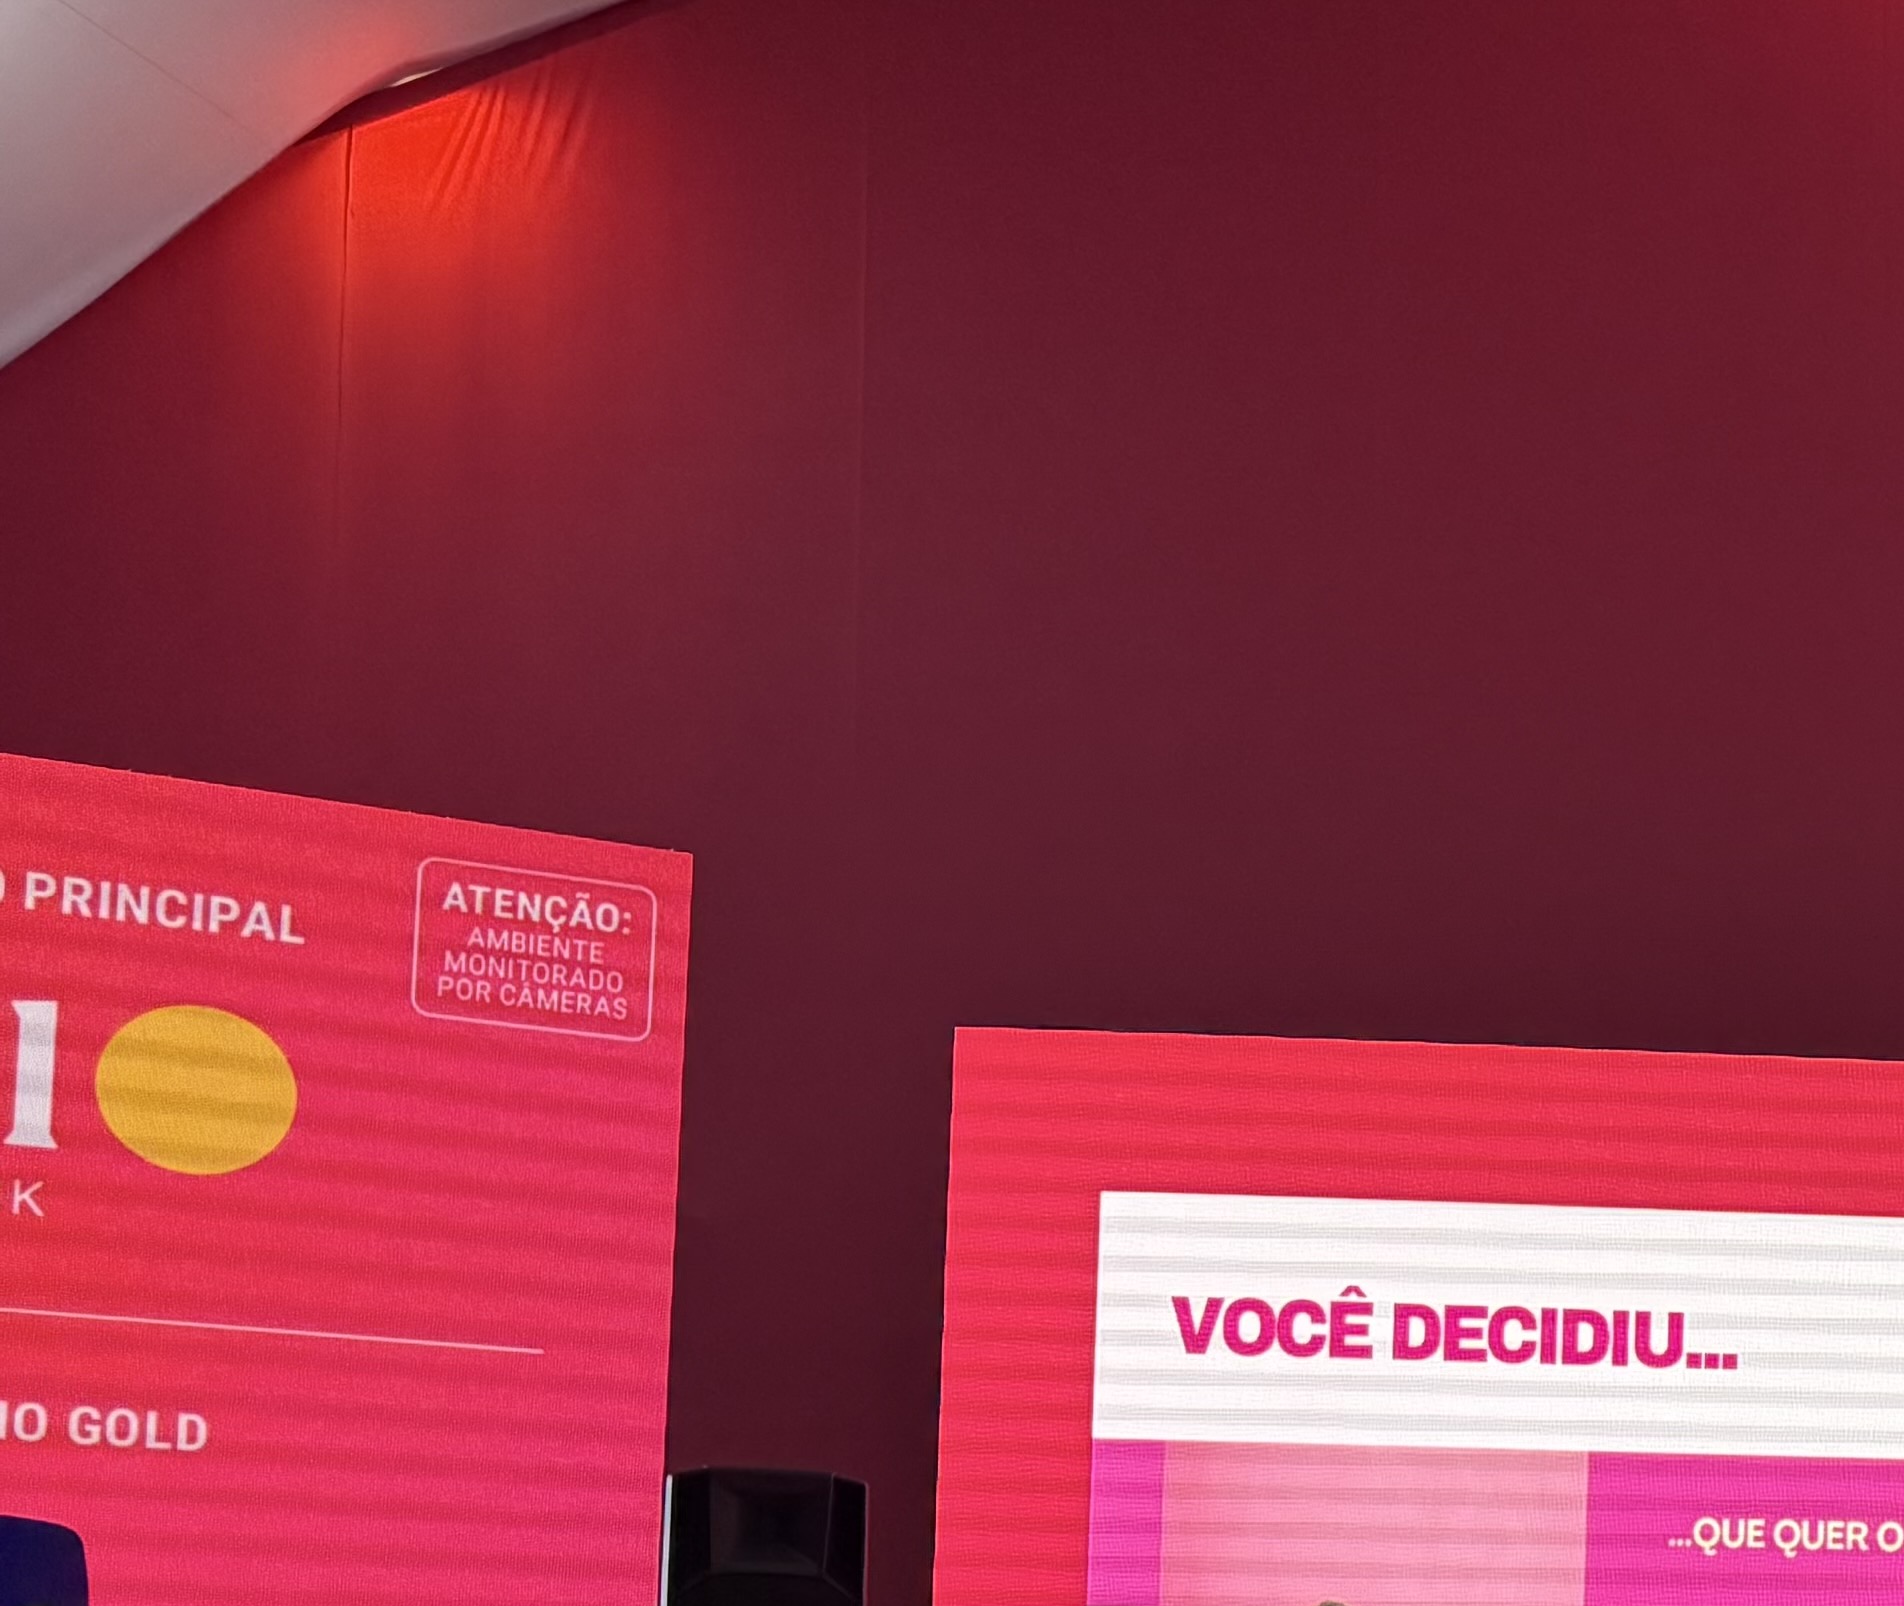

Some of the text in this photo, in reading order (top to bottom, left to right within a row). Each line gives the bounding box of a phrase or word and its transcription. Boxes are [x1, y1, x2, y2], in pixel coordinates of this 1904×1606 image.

[25, 871, 304, 944] PRINCIPAL
[443, 881, 631, 935] ATENÇÃO:
[467, 927, 604, 964] AMBIENTE
[444, 950, 624, 993] MONITORADO
[438, 976, 627, 1020] POR CÂMERAS
[1172, 1285, 1739, 1370] VOCÊ DECIDIU...
[68, 1405, 207, 1451] GOLD
[1668, 1517, 1765, 1556] ...QUE
[1773, 1519, 1869, 1558] QUER
[1876, 1521, 1904, 1553] O
